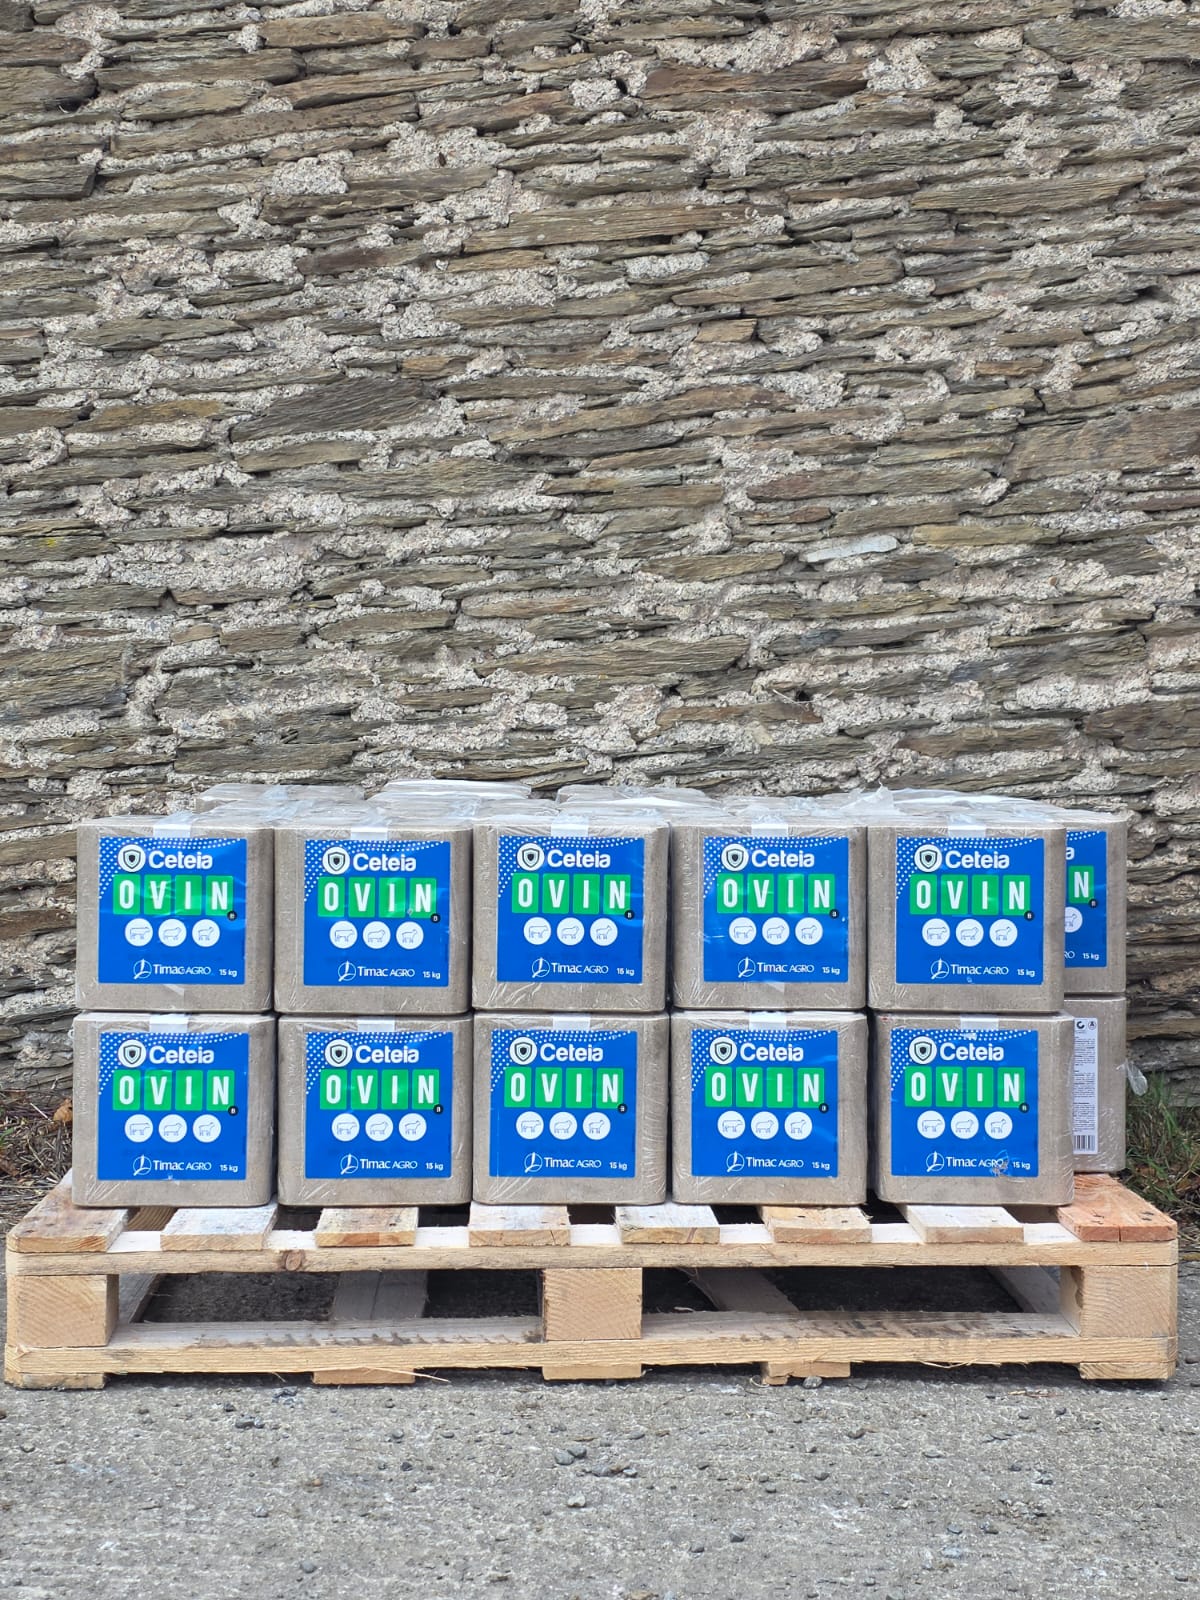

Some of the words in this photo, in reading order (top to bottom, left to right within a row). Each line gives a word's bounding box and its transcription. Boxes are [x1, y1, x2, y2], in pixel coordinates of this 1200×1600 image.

[148, 850, 213, 870] Ceteia
[353, 853, 416, 872] Ceteia
[548, 850, 611, 868] Ceteia
[752, 850, 815, 868] Ceteia
[945, 850, 1010, 869] Ceteia
[119, 880, 228, 910] OVIN
[324, 882, 432, 912] OVIN
[518, 878, 626, 909] OVIN
[723, 879, 830, 908] OVIN
[916, 880, 1025, 910] OVIN
[184, 967, 211, 975] AGRO
[228, 969, 237, 977] kg
[357, 966, 388, 976] Timac
[390, 968, 415, 977] AGRO
[432, 971, 441, 979] kg
[551, 963, 582, 973] Timac
[584, 965, 608, 974] AGRO
[626, 968, 634, 976] kg
[757, 962, 788, 972] Timac
[789, 964, 814, 973] AGRO
[831, 967, 840, 975] kg
[951, 964, 982, 974] Timac
[983, 966, 1009, 975] AGRO
[1026, 969, 1036, 977] kg
[149, 1046, 214, 1064] Ceteia
[355, 1045, 419, 1064] Ceteia
[540, 1043, 604, 1062] Ceteia
[740, 1043, 804, 1062] Ceteia
[940, 1042, 1004, 1061] Ceteia
[120, 1076, 229, 1105] OVIN
[326, 1075, 434, 1104] OVIN
[511, 1073, 618, 1103] OVIN
[712, 1072, 819, 1102] OVIN
[911, 1072, 1020, 1102] OVIN
[153, 1160, 184, 1170] Timac
[186, 1162, 212, 1170] AGRO
[360, 1158, 390, 1169] Timac
[392, 1161, 418, 1169] AGRO
[434, 1163, 444, 1171] kg
[544, 1157, 574, 1168] Timac
[576, 1160, 602, 1168] AGRO
[618, 1162, 627, 1170] kg
[746, 1157, 777, 1167] Timac
[778, 1160, 804, 1168] AGRO
[821, 1162, 830, 1170] kg
[946, 1156, 977, 1167] Timac
[1022, 1162, 1030, 1170] kg
